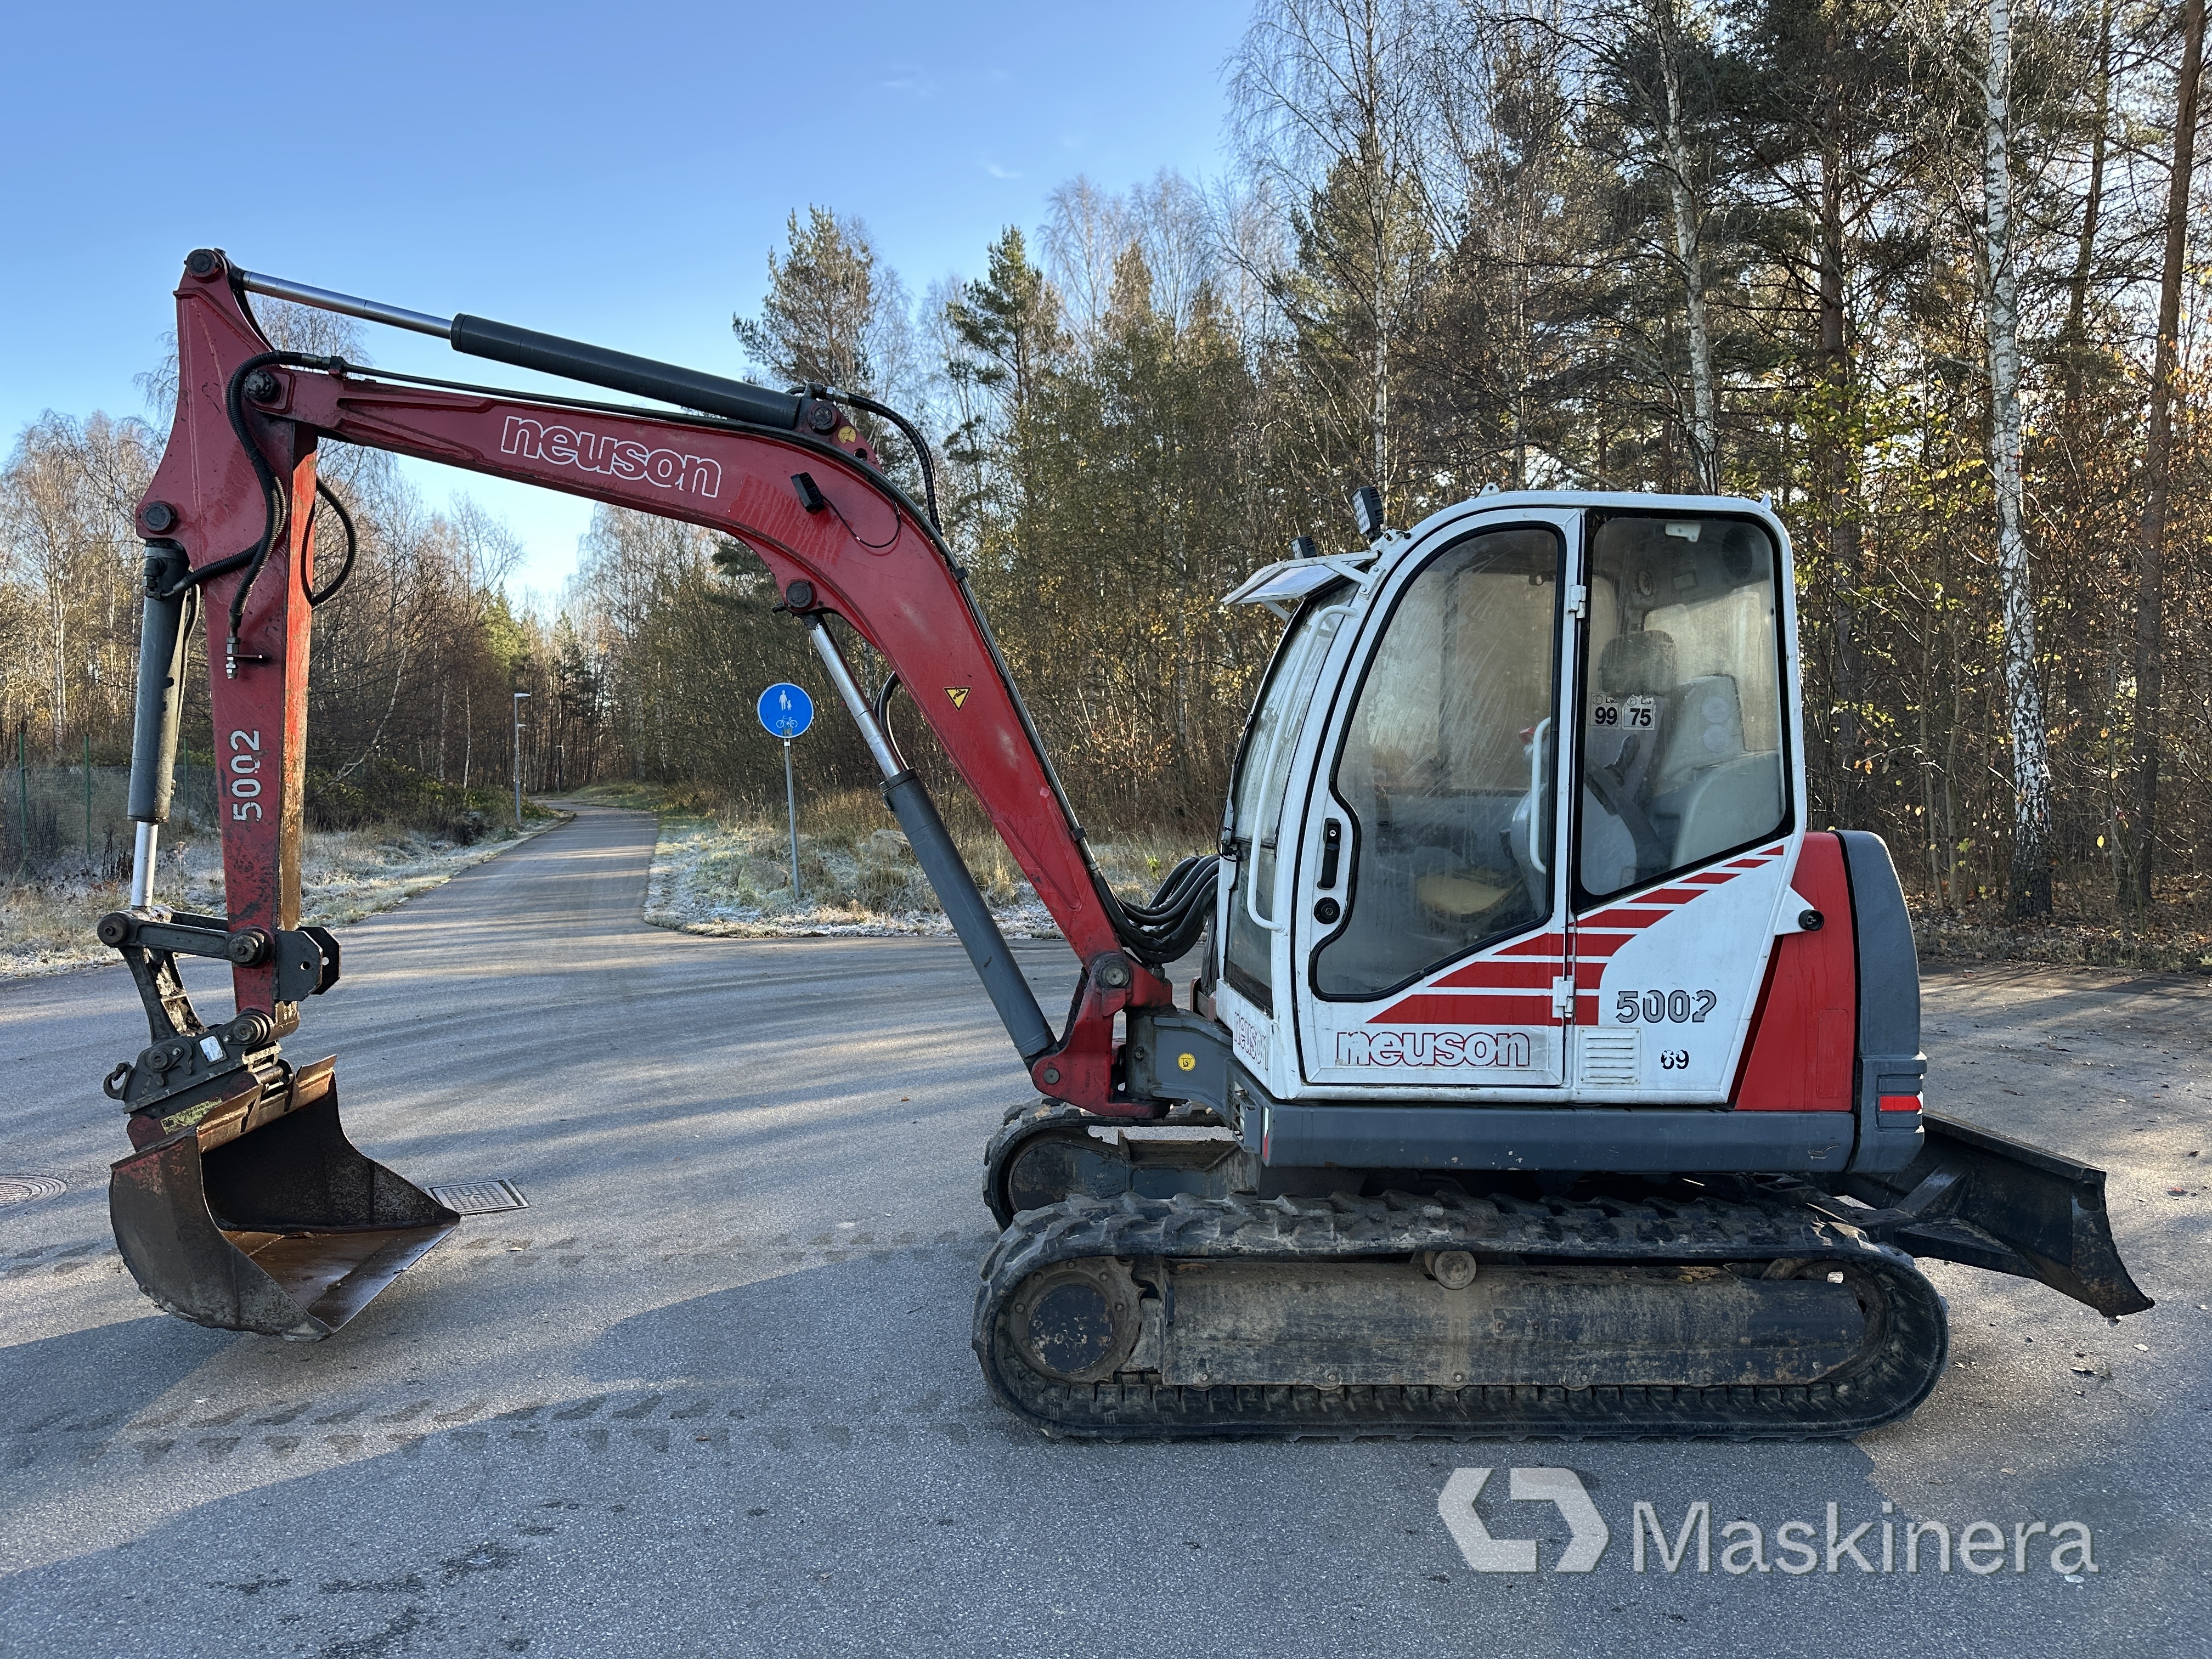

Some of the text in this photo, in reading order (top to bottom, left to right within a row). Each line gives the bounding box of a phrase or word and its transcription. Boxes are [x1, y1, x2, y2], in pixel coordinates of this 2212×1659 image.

[500, 415, 721, 498] neuson
[1595, 706, 1618, 725] 99
[1630, 708, 1651, 726] 75
[229, 729, 262, 822] 5002
[1615, 989, 1717, 1024] 5002
[1234, 1011, 1268, 1071] neuson
[1336, 1031, 1530, 1066] neuson
[1660, 1049, 1690, 1070] 69
